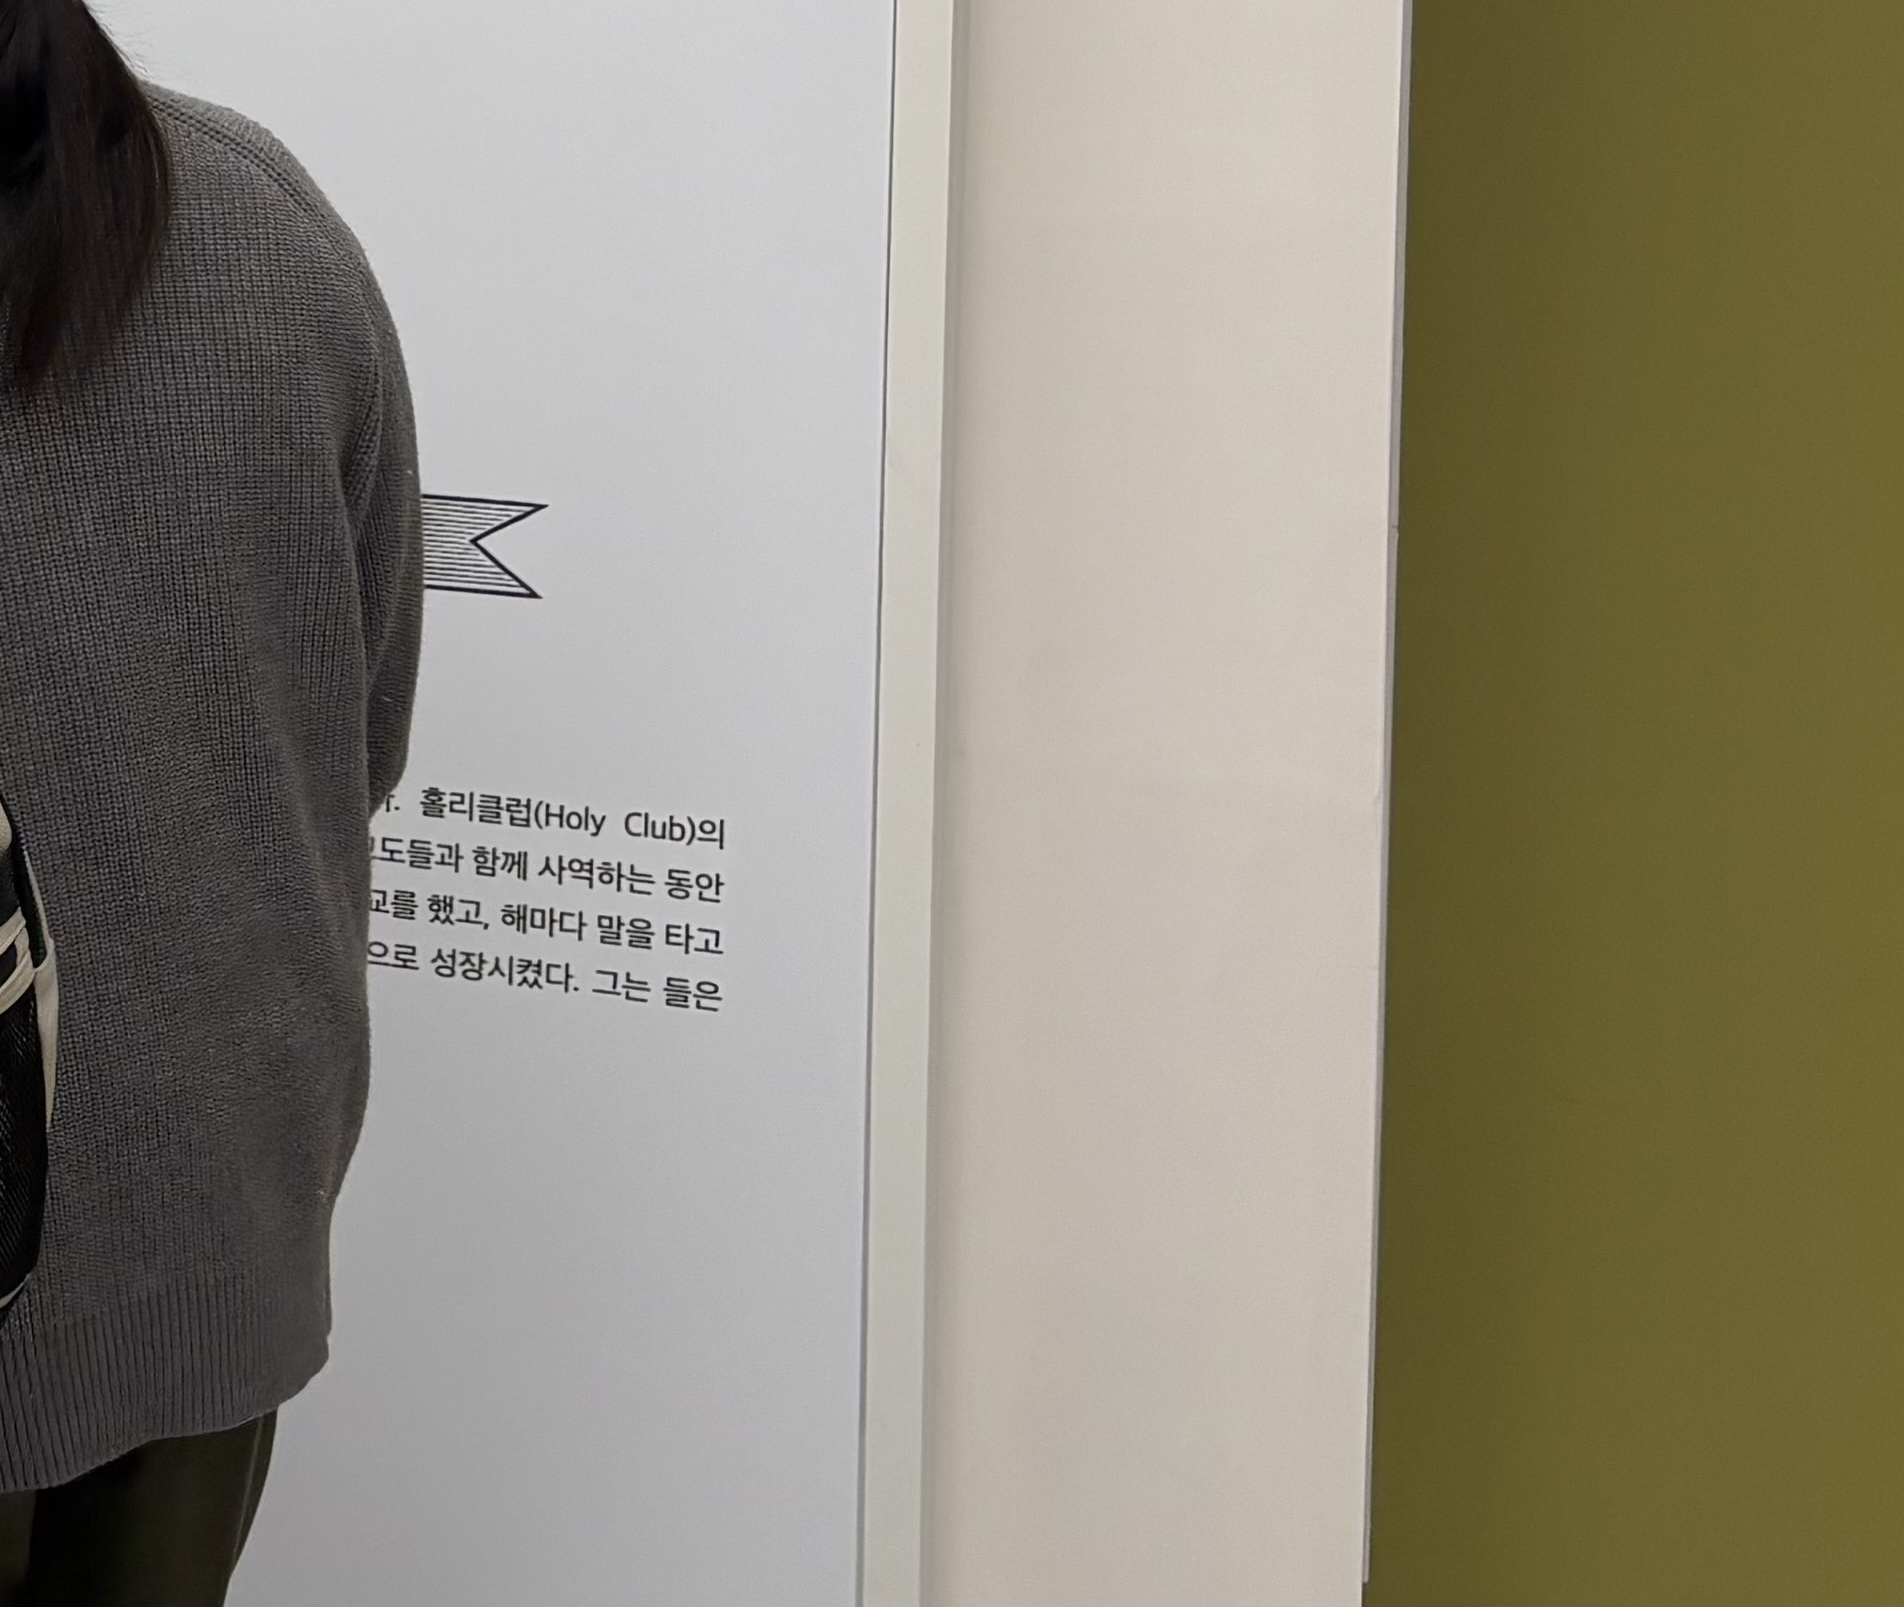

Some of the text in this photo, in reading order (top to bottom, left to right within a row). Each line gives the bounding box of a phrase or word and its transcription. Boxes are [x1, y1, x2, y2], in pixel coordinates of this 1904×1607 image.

[471, 845, 726, 904] 함께 사역하는 동안
[426, 893, 724, 955] 했고, 해마다 말을 타고
[429, 947, 580, 994] 성장시켰다.
[591, 969, 652, 1004] 그는
[662, 976, 723, 1013] 들은
